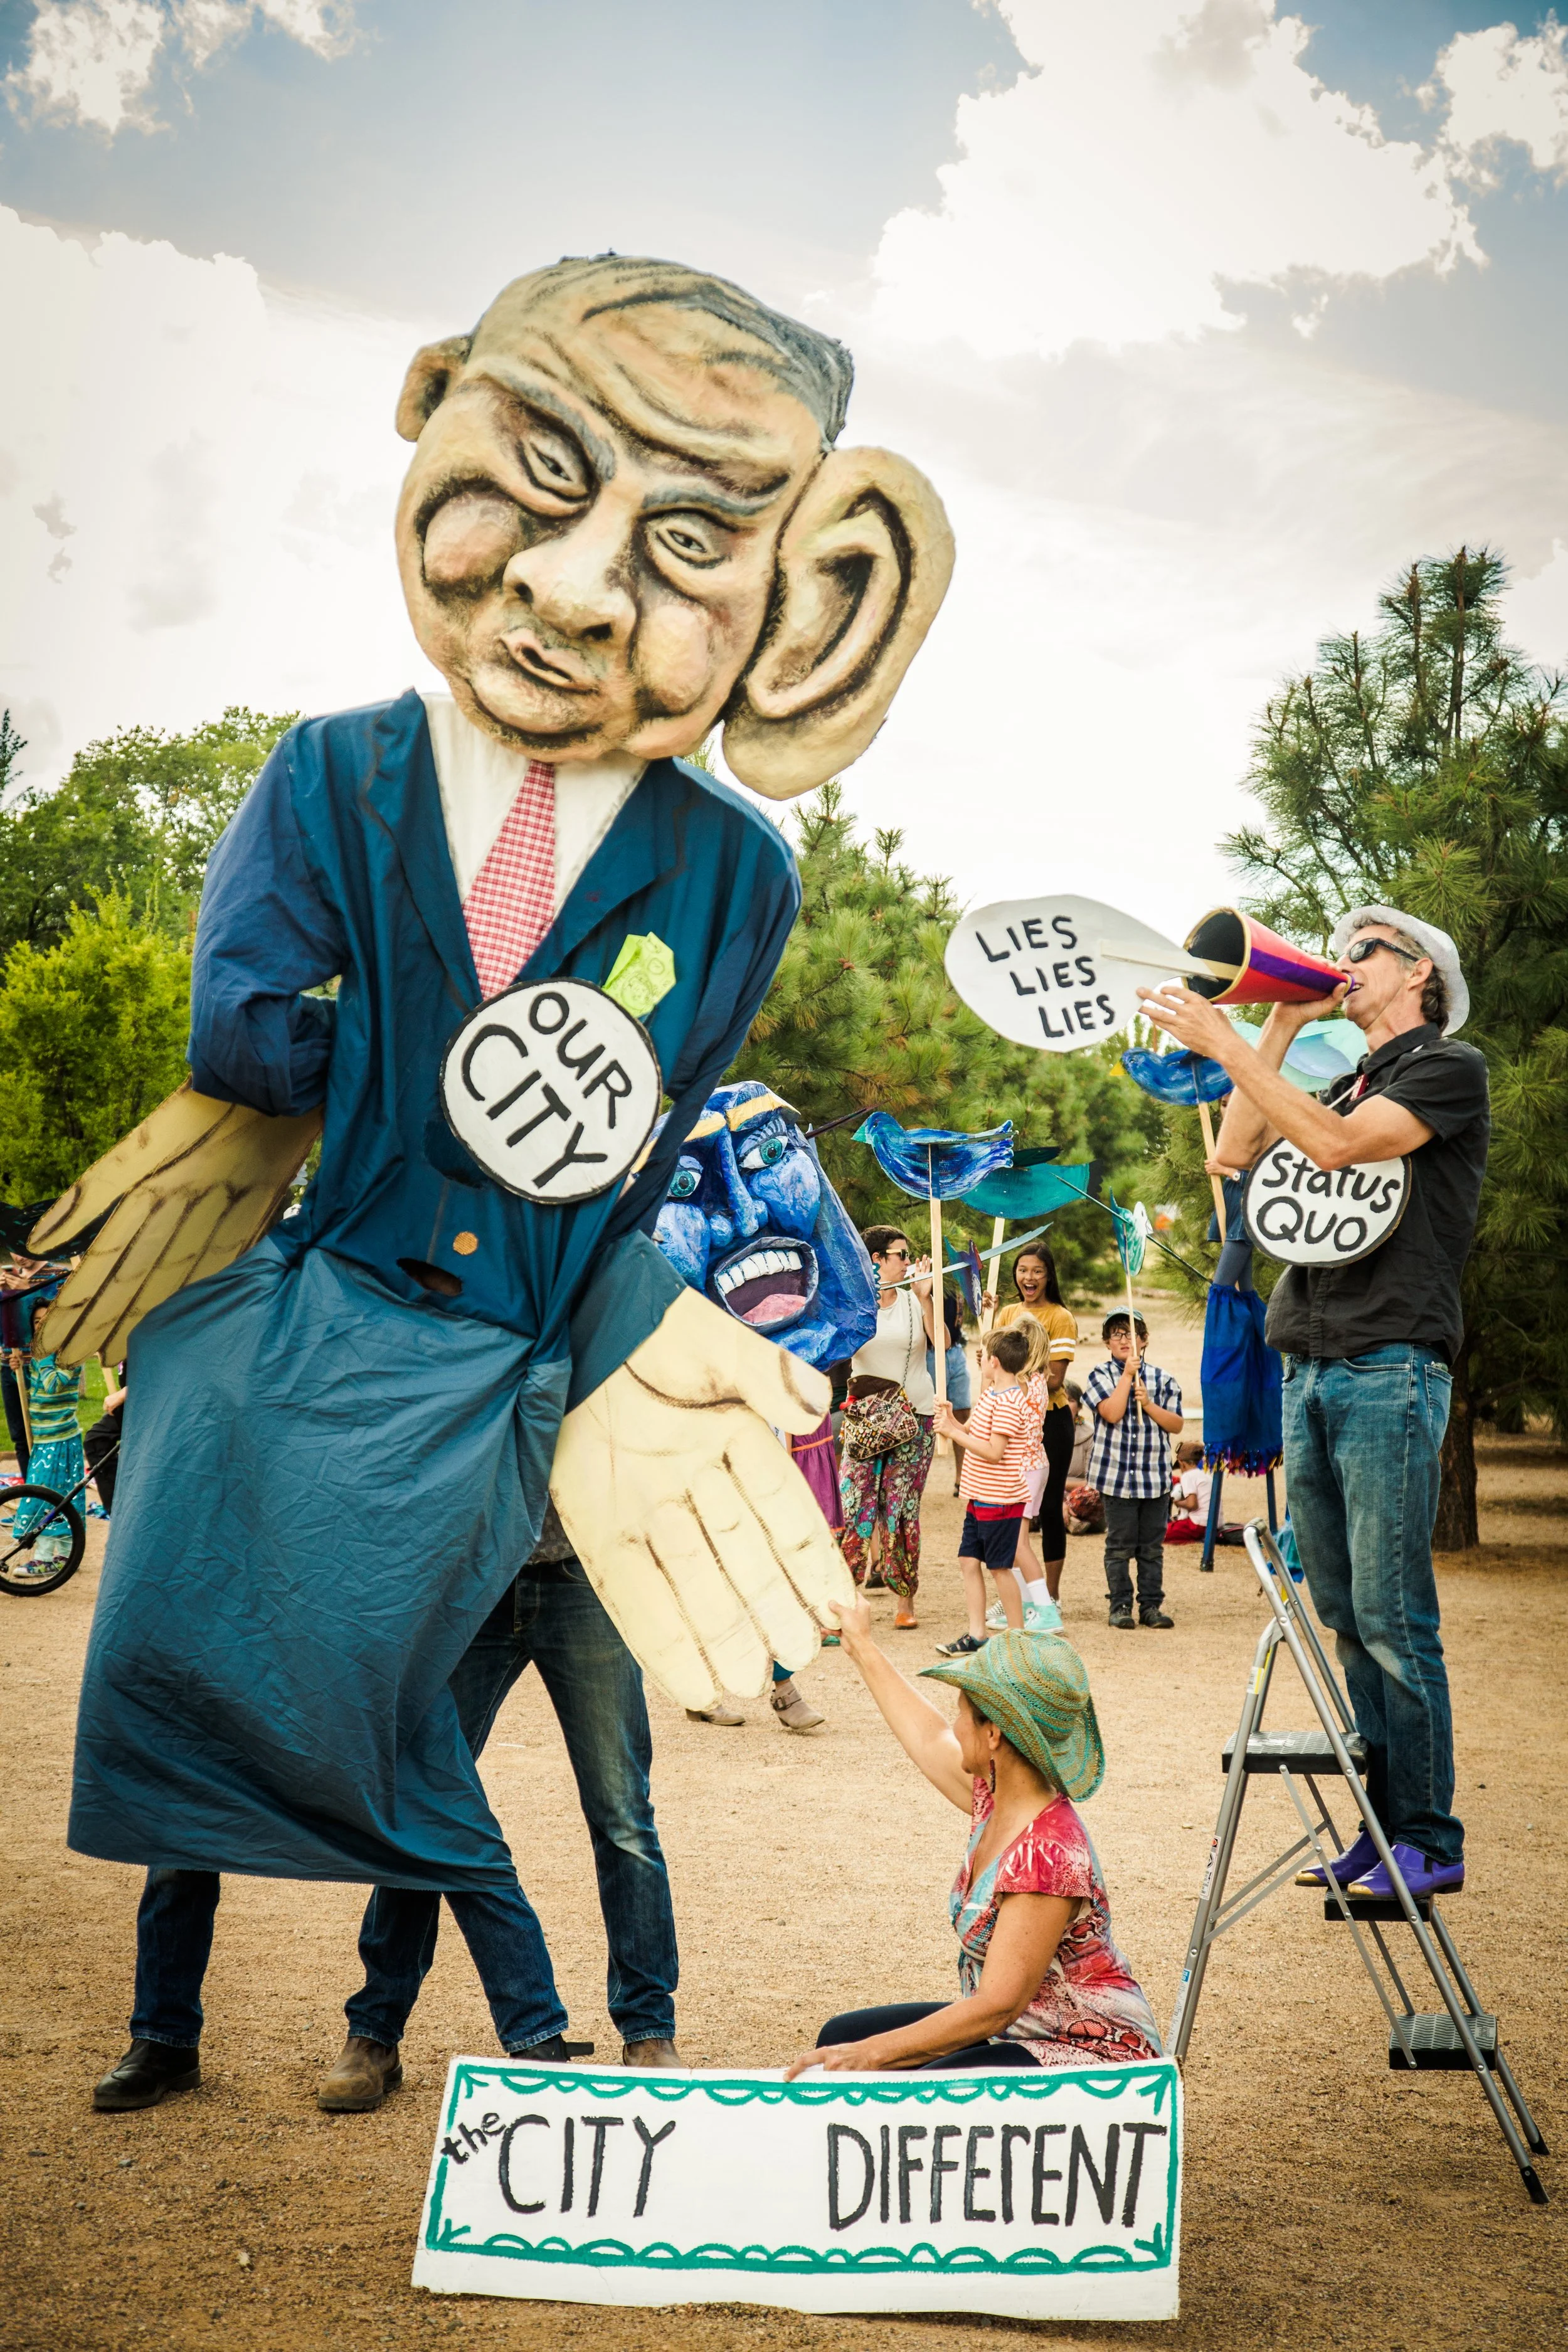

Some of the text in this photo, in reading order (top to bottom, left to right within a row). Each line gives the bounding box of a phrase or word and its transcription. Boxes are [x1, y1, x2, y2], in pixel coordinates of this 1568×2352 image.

[975, 915, 1078, 963] LIES
[1009, 955, 1096, 996] LIES
[1038, 993, 1115, 1038] LIES
[528, 990, 633, 1130] OUR
[461, 1023, 608, 1189] CITY
[1261, 1152, 1401, 1214] Status
[1256, 1195, 1367, 1252] QUO
[440, 2112, 507, 2165] the
[497, 2114, 676, 2218] CITY
